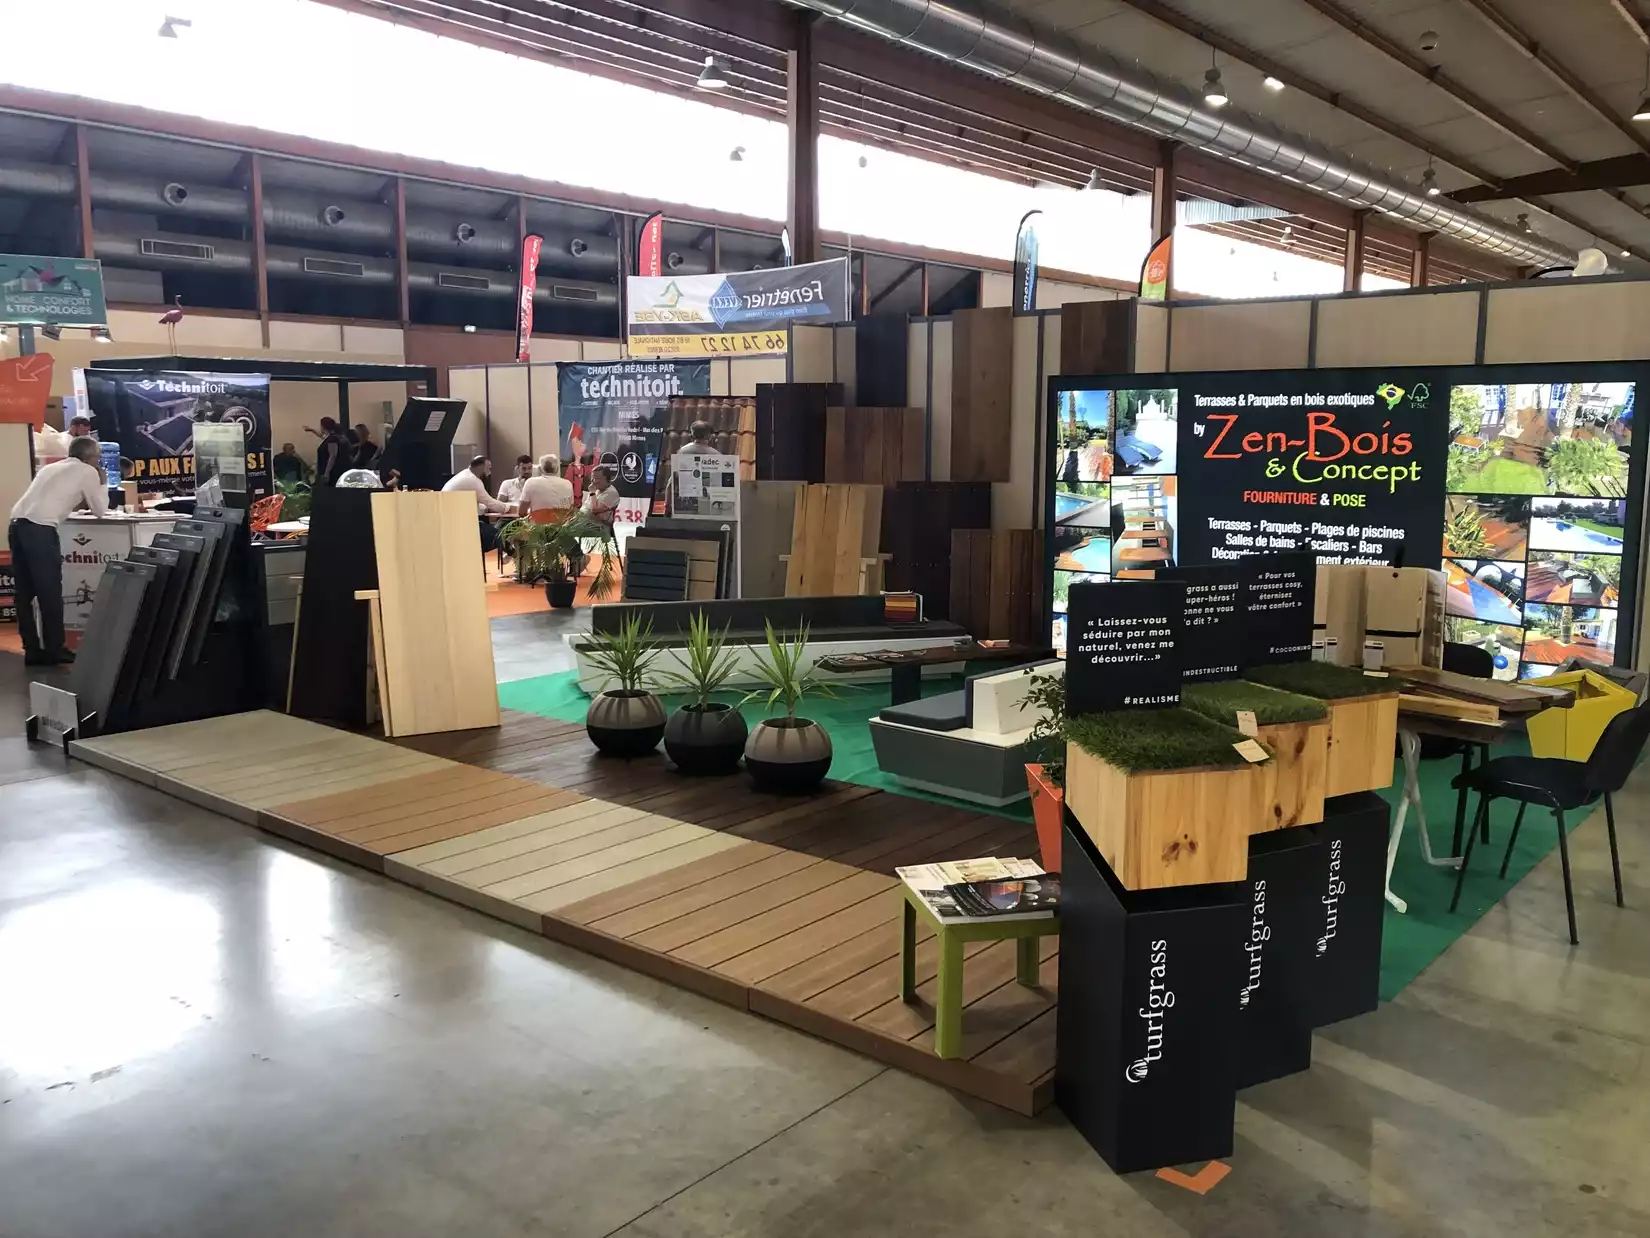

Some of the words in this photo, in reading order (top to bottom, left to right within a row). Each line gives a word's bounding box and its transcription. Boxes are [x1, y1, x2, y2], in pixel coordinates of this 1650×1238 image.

[5, 295, 36, 304] HOME
[43, 296, 91, 306] CONFORT
[15, 304, 93, 315] TECHNOLOGIES
[588, 365, 623, 375] CHANTIER
[625, 363, 657, 374] RÉALISÉ
[659, 364, 674, 373] PAR
[156, 379, 226, 394] Technitoit
[1194, 394, 1236, 407] Terrasses
[1238, 394, 1246, 407] &
[1247, 394, 1288, 408] Parquets
[1290, 396, 1303, 406] en
[1304, 393, 1326, 406] bois
[1328, 393, 1375, 408] exotiques
[1193, 422, 1205, 437] by
[1203, 412, 1413, 461] Zen-Bois
[149, 457, 180, 477] AUX
[1265, 458, 1286, 478] &
[1292, 451, 1422, 493] Concept
[1243, 490, 1317, 505] FOURNITURE
[1320, 493, 1330, 506] &
[1333, 494, 1366, 507] POSE
[1208, 517, 1251, 531] Terrasses
[1260, 520, 1302, 535] Parquets
[1312, 522, 1344, 538] Plages
[1346, 524, 1360, 537] de
[1362, 525, 1405, 540] piscines
[1226, 533, 1253, 546] Salles
[1255, 534, 1267, 547] de
[1269, 535, 1296, 549] bains
[1359, 541, 1383, 555] Bars
[1316, 555, 1342, 566] ment
[1265, 572, 1282, 580] Pour
[1186, 585, 1209, 595] grass
[1218, 582, 1239, 591] aussi
[1249, 582, 1283, 591] terrasses
[1285, 581, 1303, 589] cosy,
[1186, 593, 1230, 605] uper-héros
[1259, 592, 1292, 600] éternisez
[1184, 607, 1203, 615] onne
[1204, 606, 1214, 614] ne
[1216, 605, 1234, 613] vous
[1248, 602, 1267, 611] vôtre
[1269, 601, 1296, 610] confort
[1098, 617, 1168, 627] Laissez-vous
[1193, 617, 1205, 625] dit
[1207, 616, 1212, 625] ?
[1083, 630, 1124, 640] séduire
[1127, 630, 1146, 640] par
[1149, 629, 1171, 637] mon
[1078, 642, 1122, 652] naturel,
[1126, 642, 1156, 650] venez
[1183, 665, 1238, 677] INDESTRUCTIBLE
[1124, 695, 1180, 705] #REALISME
[1322, 839, 1346, 941] turfgrass
[1244, 880, 1272, 992] turfgrass
[1139, 939, 1176, 1064] turfgrass
